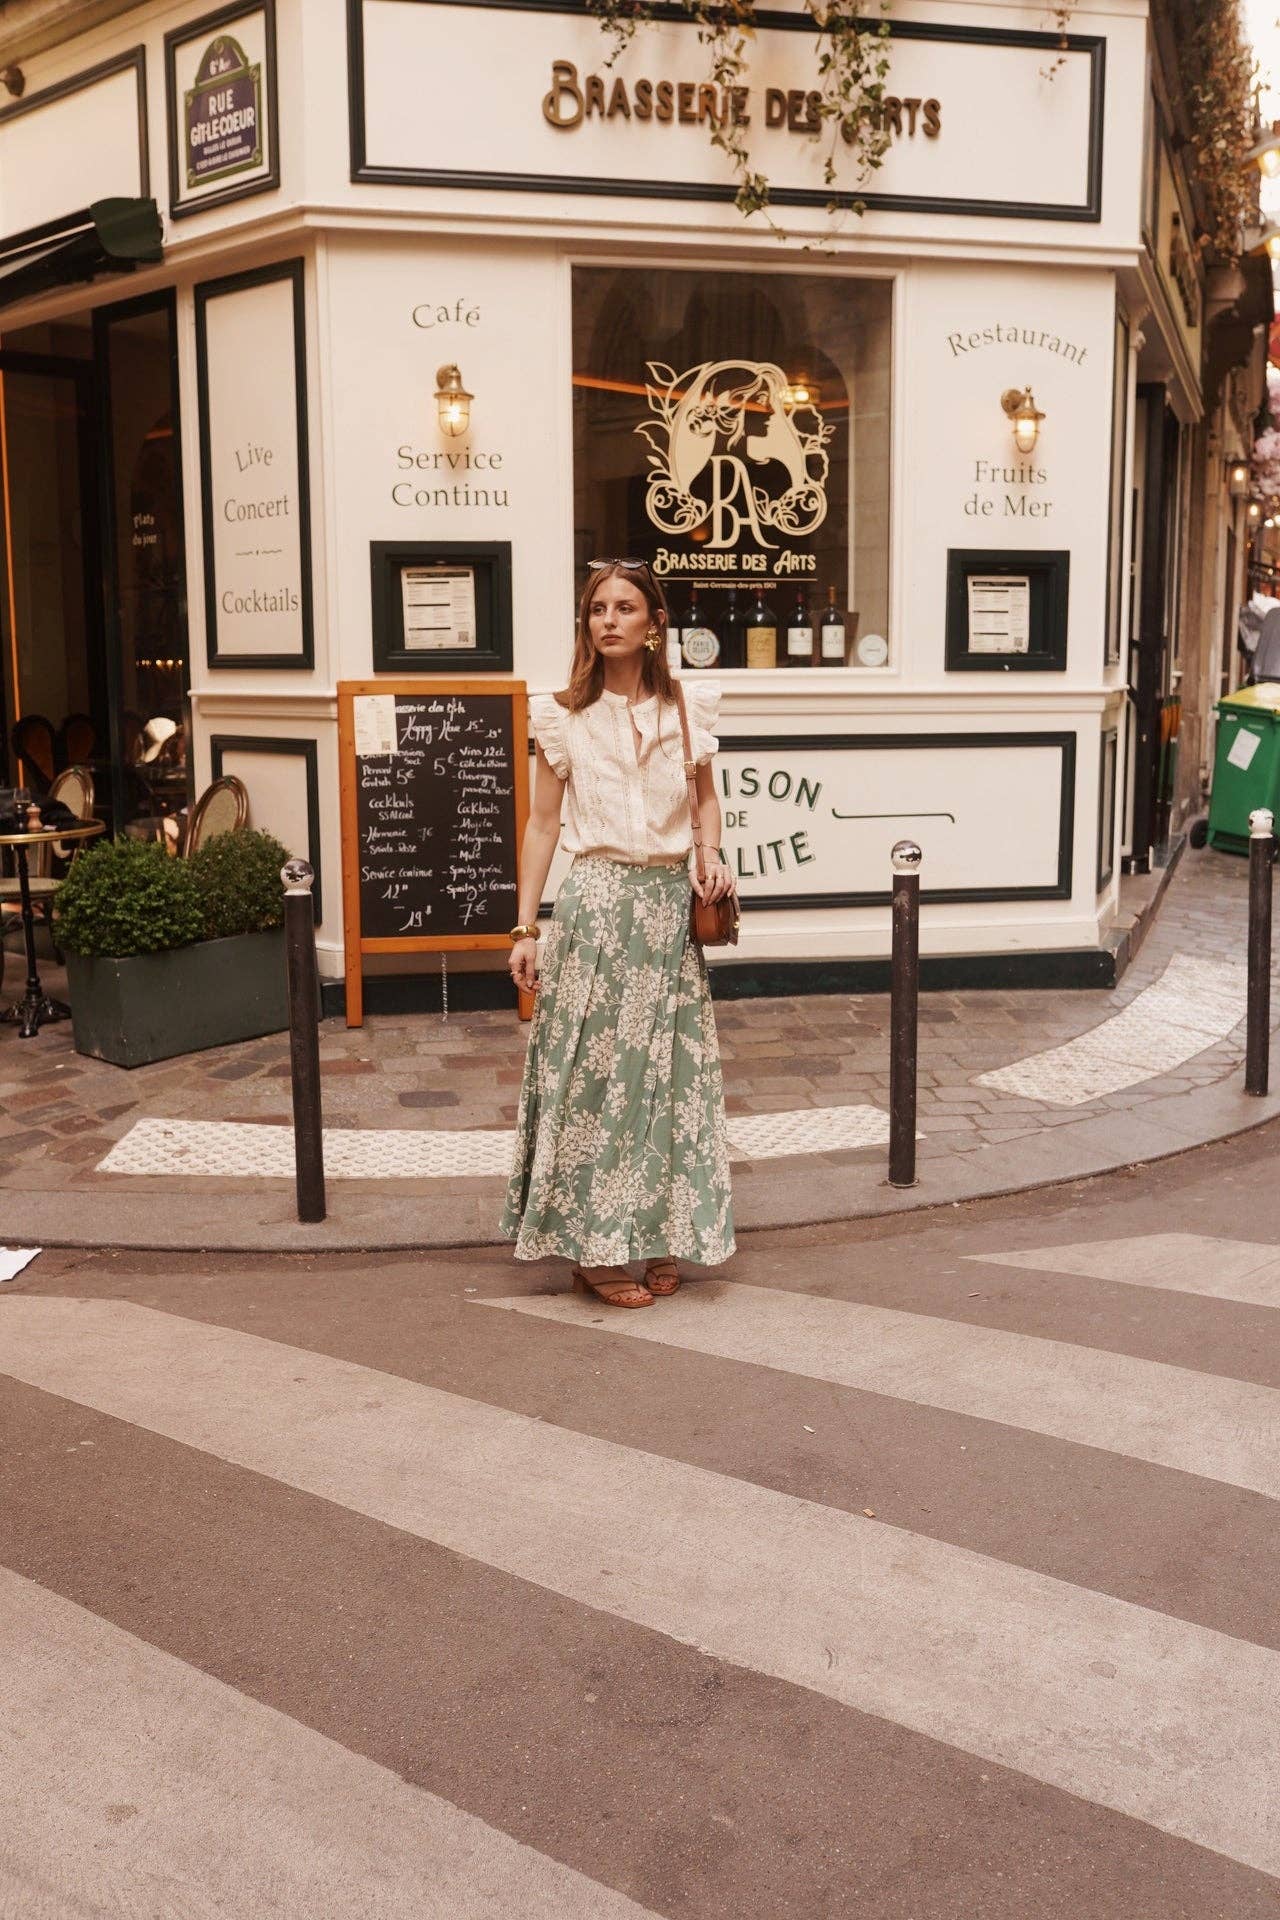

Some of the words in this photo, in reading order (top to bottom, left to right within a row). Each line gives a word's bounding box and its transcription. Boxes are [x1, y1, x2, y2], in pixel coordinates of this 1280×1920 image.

[208, 88, 234, 117] RUE
[765, 88, 822, 132] DES
[412, 298, 480, 328] Café
[947, 323, 1088, 366] Restaurant
[235, 442, 273, 472] Live
[397, 446, 503, 470] Service
[975, 460, 1048, 484] Fruits
[392, 482, 510, 507] Continu
[964, 493, 994, 516] de
[1003, 494, 1053, 517] Mer
[224, 495, 289, 523] Concert
[652, 548, 738, 575] BRASSERIE
[742, 554, 767, 571] DES
[773, 550, 816, 575] ARTS
[222, 587, 299, 614] Cocktails
[722, 767, 822, 812] ISON
[726, 811, 748, 828] DE
